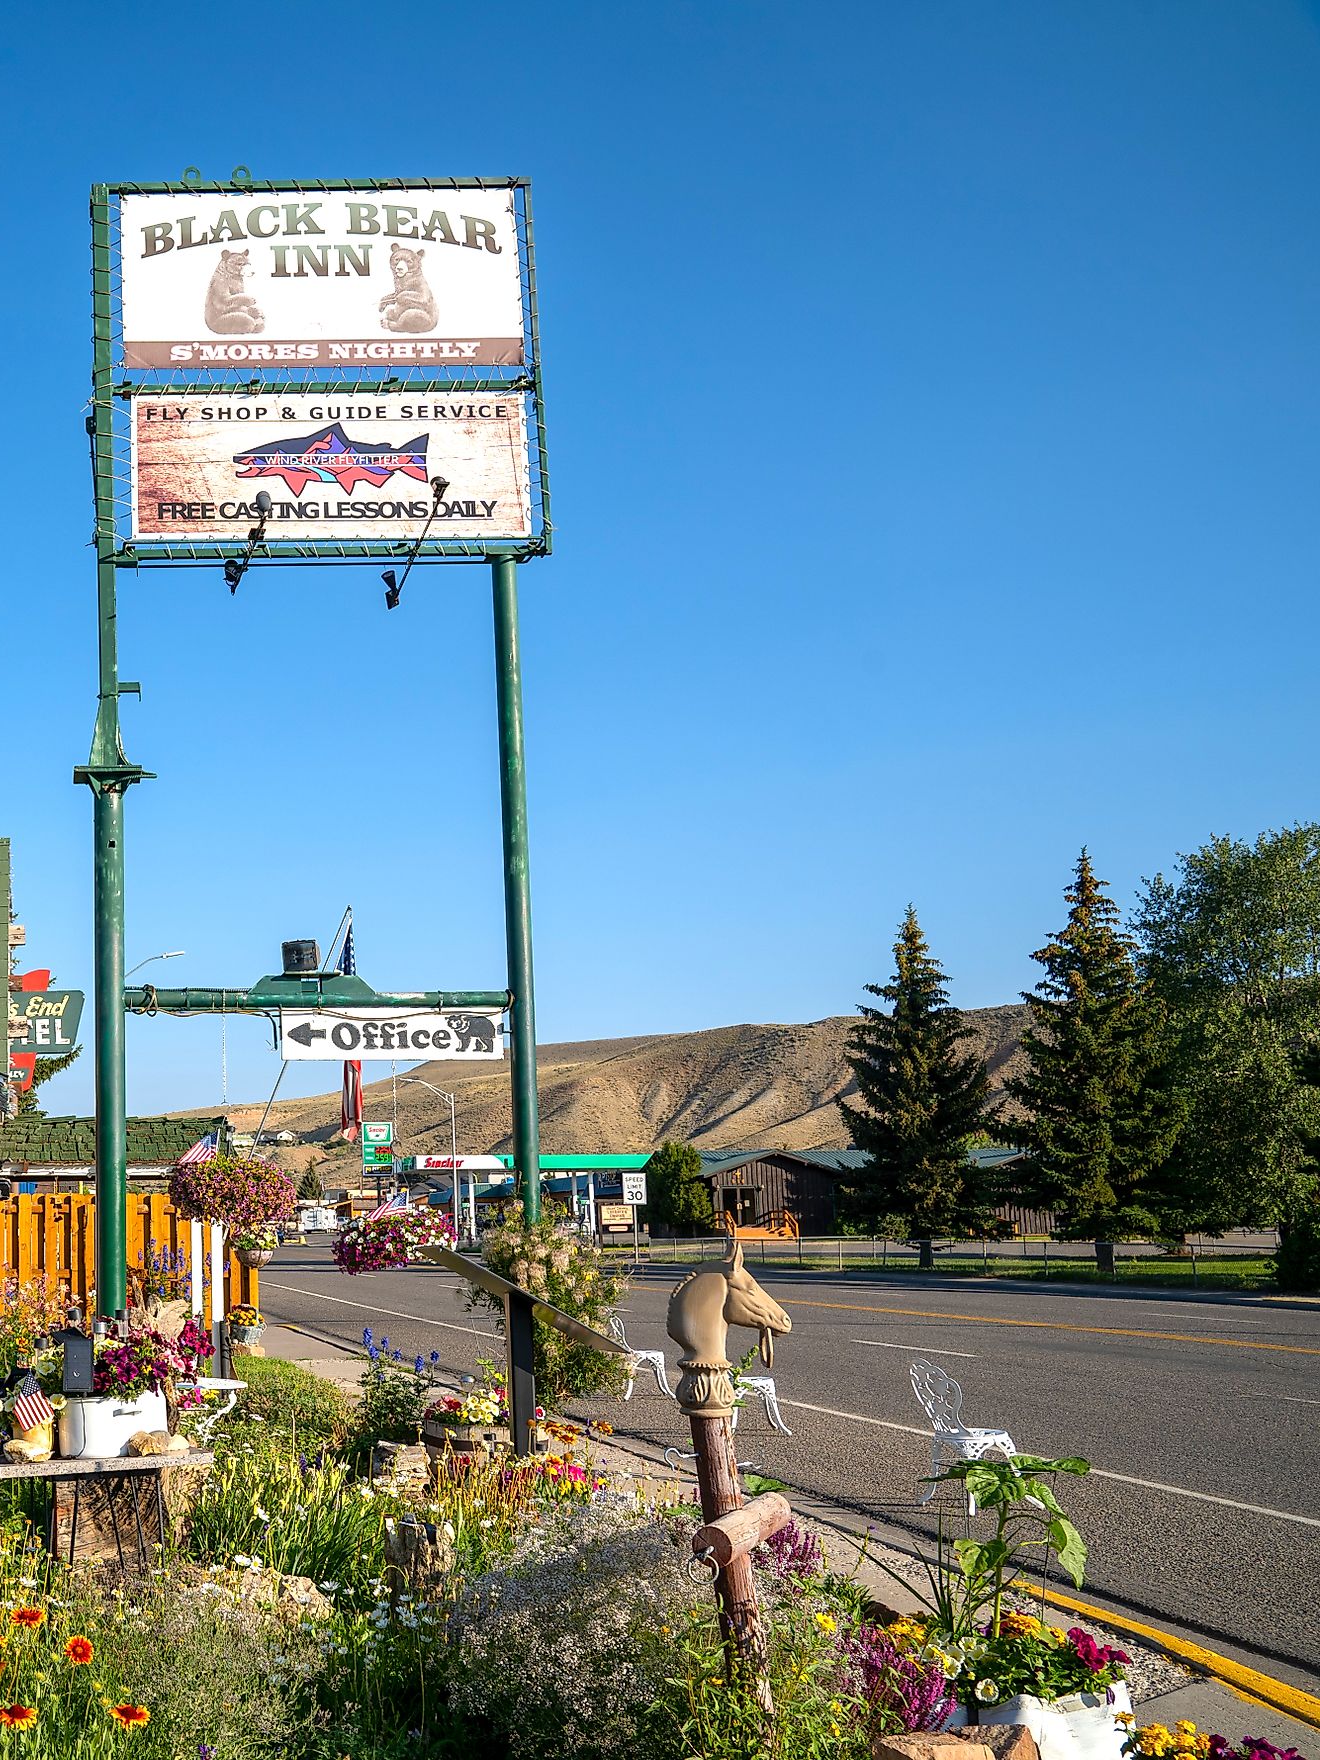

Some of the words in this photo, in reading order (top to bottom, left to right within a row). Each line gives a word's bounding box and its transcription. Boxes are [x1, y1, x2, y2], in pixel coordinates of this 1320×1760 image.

[140, 202, 325, 258] BLACK
[345, 202, 502, 255] BEAR
[270, 244, 372, 278] INN
[169, 341, 319, 361] S'MORES
[328, 341, 480, 359] NIGHTLY
[146, 407, 190, 421] FLY
[201, 407, 267, 420] SHOP
[282, 407, 297, 420] &
[309, 405, 390, 419] GUIDE
[400, 404, 508, 419] SERVICE
[265, 455, 298, 464] WIND
[301, 455, 336, 464] RIVER
[338, 455, 399, 464] FLYFITTER
[157, 502, 215, 519] FREE
[323, 501, 428, 519] LESSONS
[432, 500, 498, 518] DAILY
[25, 993, 70, 1018] End
[330, 1021, 452, 1051] Office
[627, 1190, 643, 1201] 30
